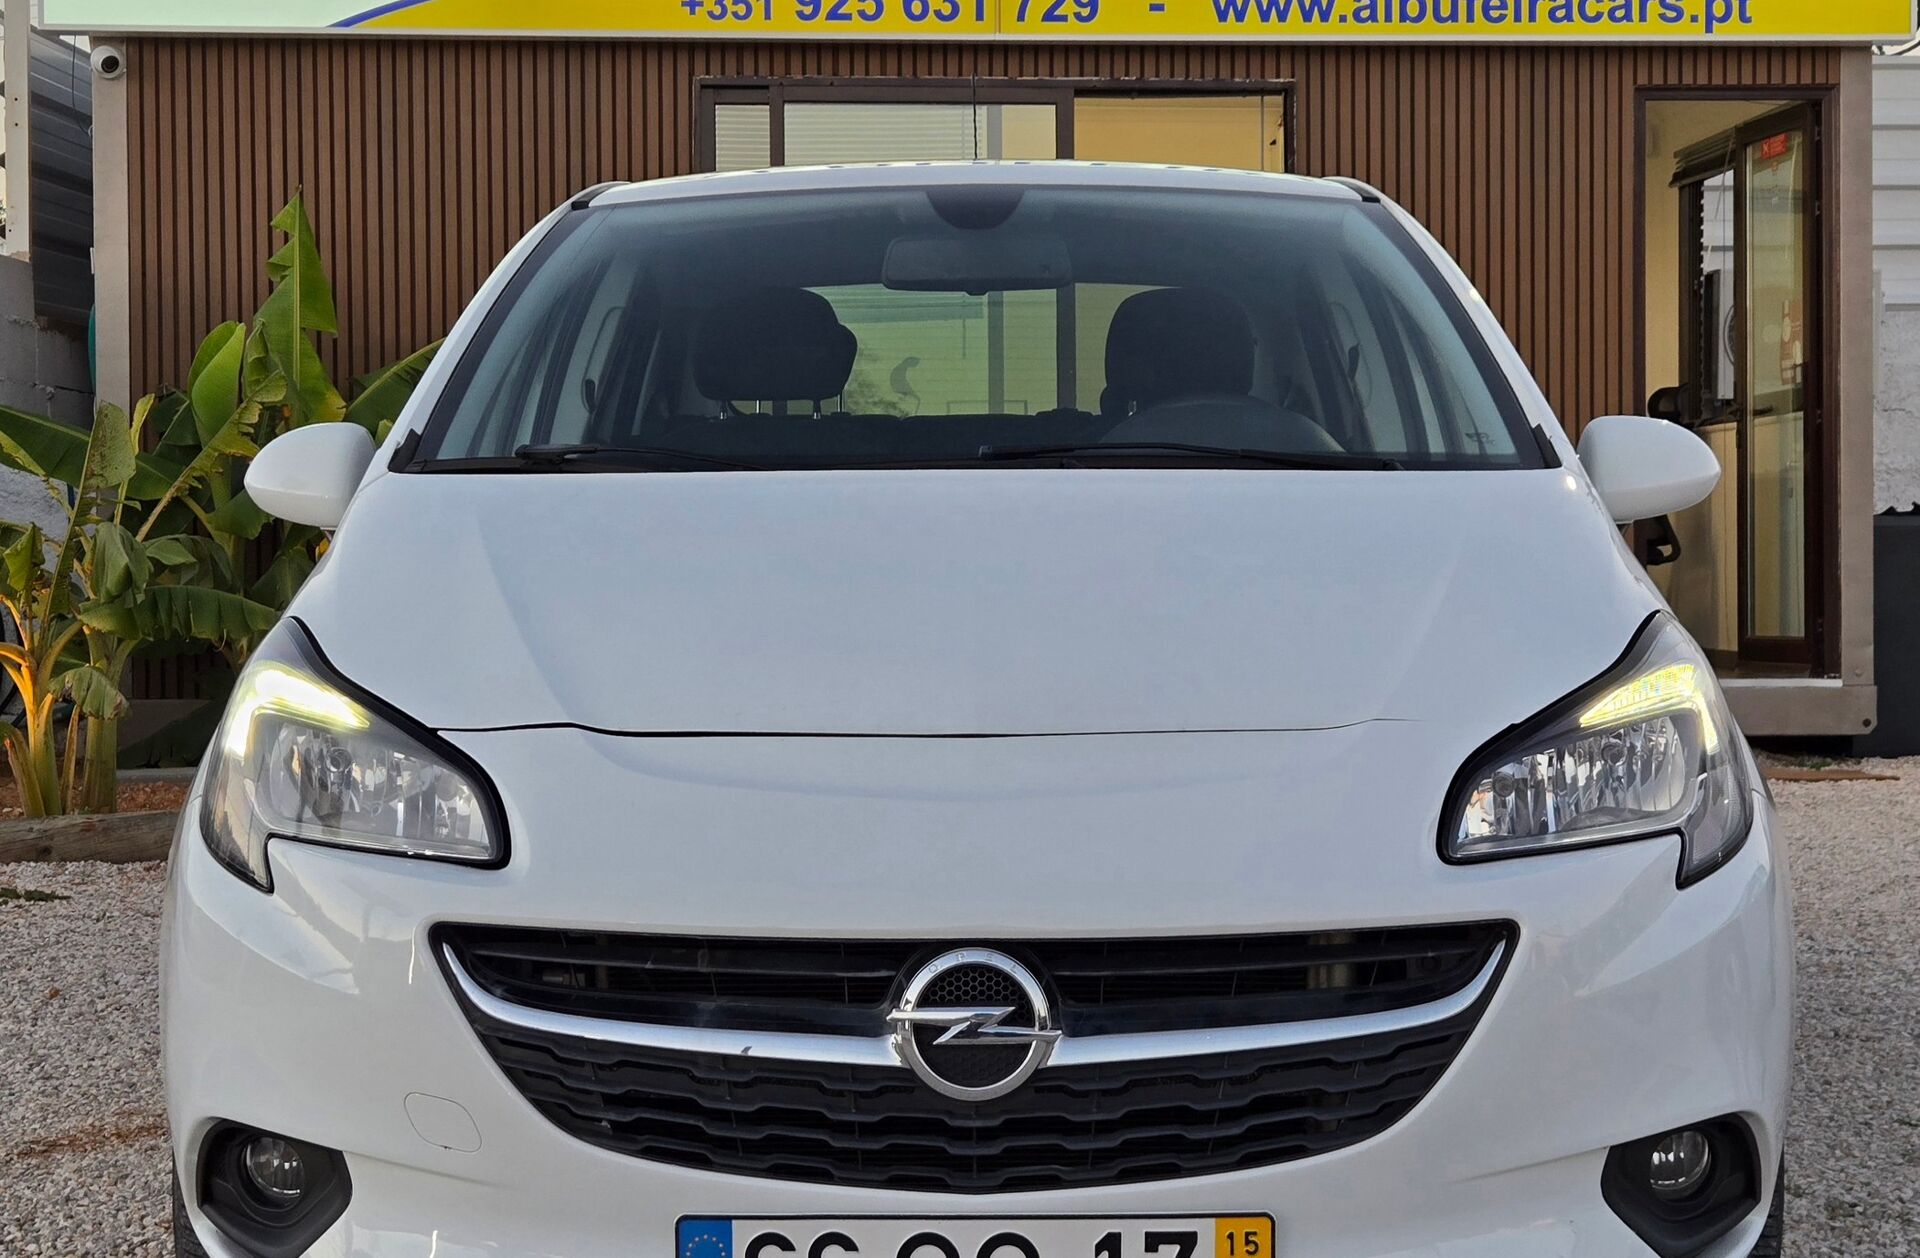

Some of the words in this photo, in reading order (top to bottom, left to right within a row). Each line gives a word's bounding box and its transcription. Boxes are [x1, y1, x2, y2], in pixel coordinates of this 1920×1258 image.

[680, 0, 772, 21] +351
[797, 0, 885, 22] 925
[903, 0, 985, 22] 631
[1018, 0, 1100, 22] 729
[1213, 0, 1752, 34] www.albufeiracars.pt
[1226, 1231, 1260, 1257] 15
